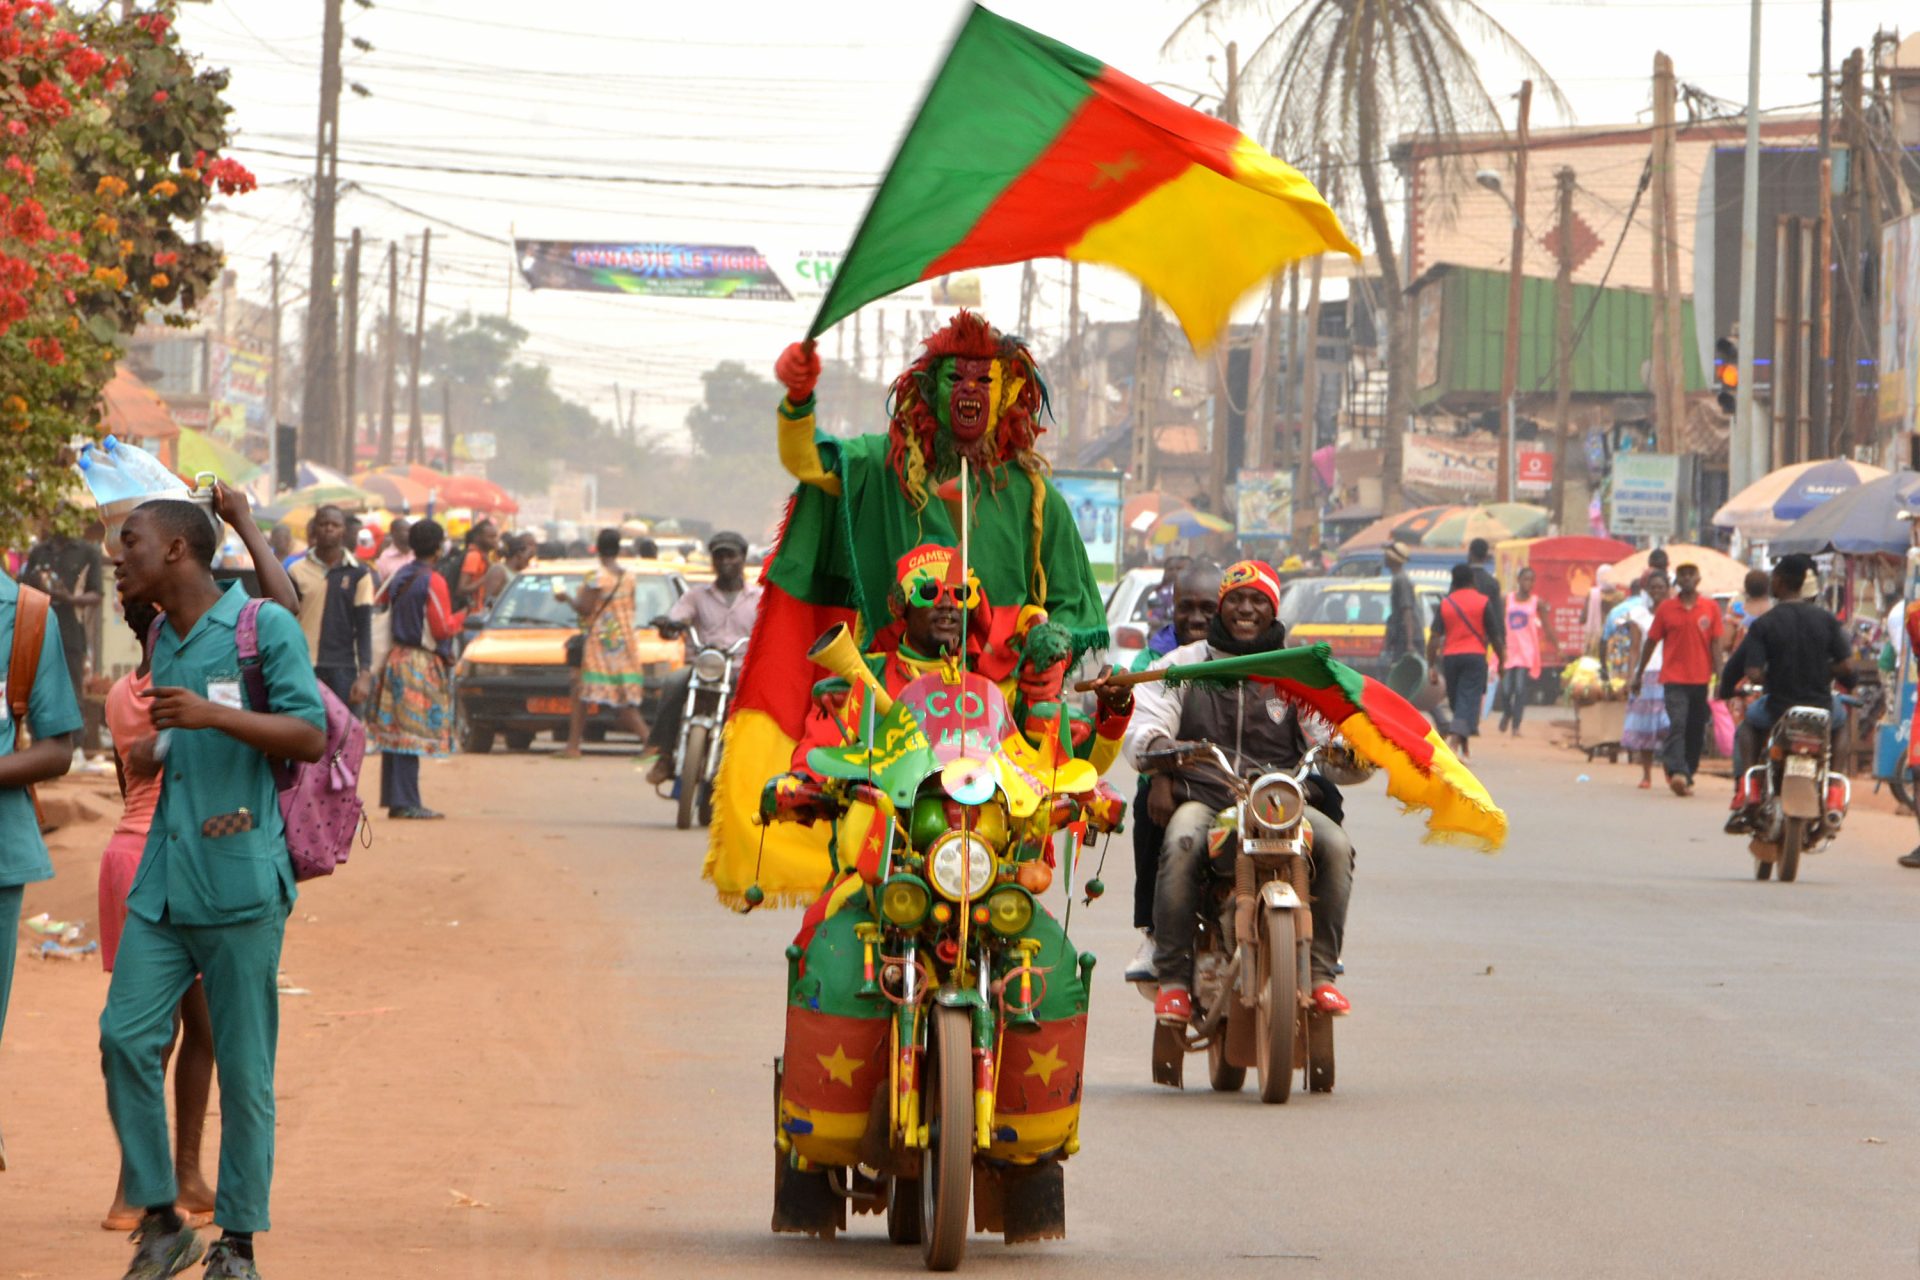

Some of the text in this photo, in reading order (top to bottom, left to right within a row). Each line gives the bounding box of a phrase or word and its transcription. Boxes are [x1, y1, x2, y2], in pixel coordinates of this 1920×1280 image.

[575, 250, 767, 271] DYNASTIE LE TIGRE
[795, 260, 833, 281] CH
